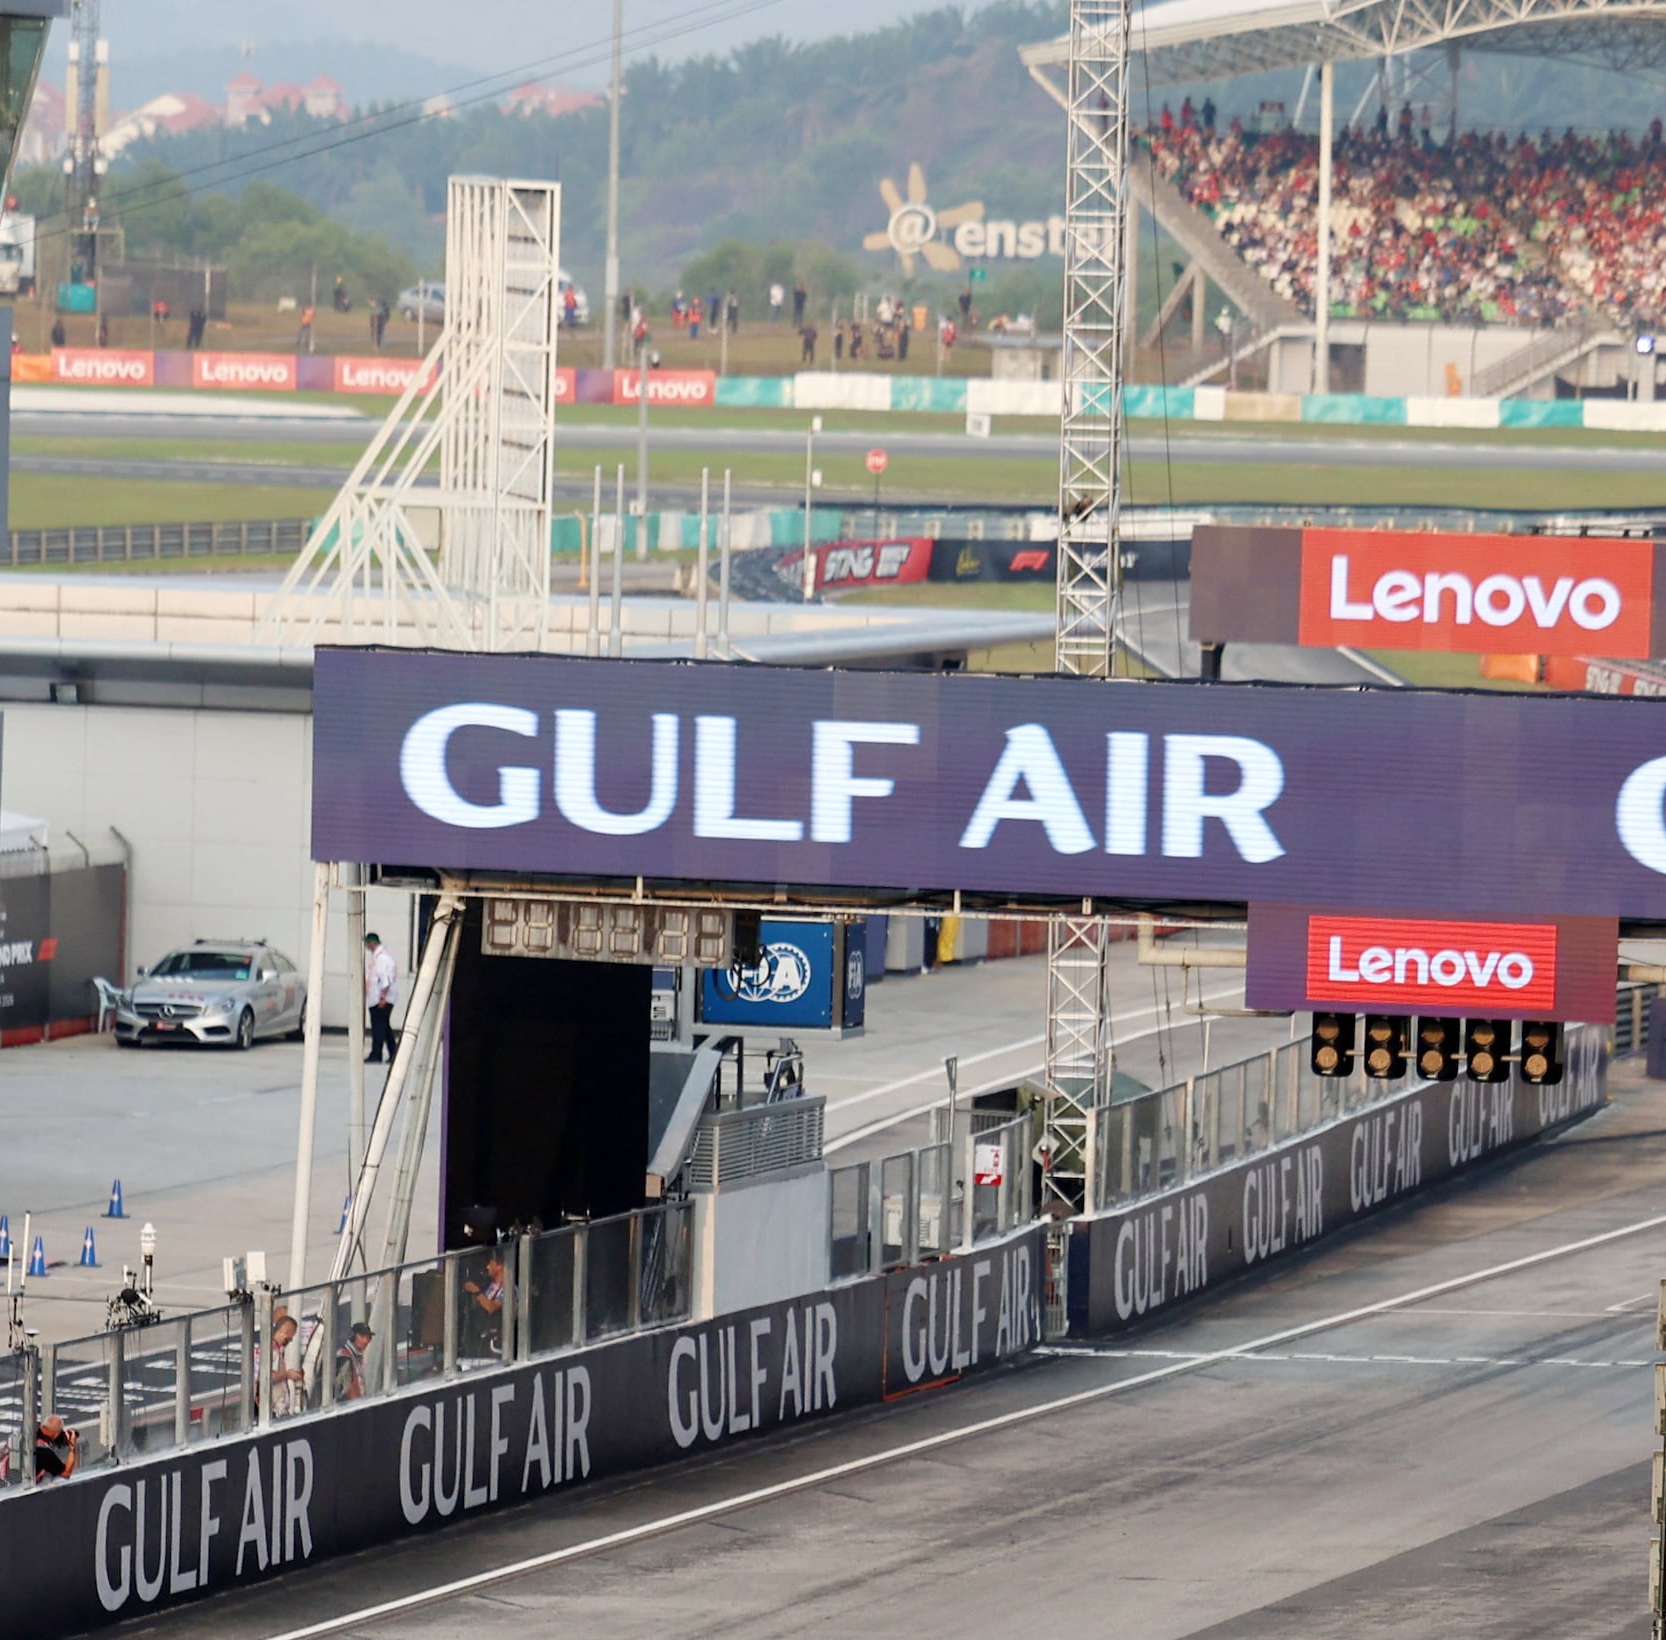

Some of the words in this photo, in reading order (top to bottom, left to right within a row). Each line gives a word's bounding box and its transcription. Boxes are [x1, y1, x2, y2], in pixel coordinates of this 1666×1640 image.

[58, 355, 145, 380] Lenovo
[202, 357, 289, 384] Lenovo
[1331, 555, 1621, 631] Lenovo
[400, 702, 920, 844] GULF
[959, 723, 1287, 864] AIR
[11, 940, 33, 966] PRIX
[1328, 935, 1534, 989] Lenovo
[1243, 1156, 1291, 1265] GULF
[1294, 1144, 1323, 1245] AIR
[1349, 1110, 1396, 1213] GULF
[1394, 1101, 1422, 1193] AIR
[902, 1260, 991, 1383] GULF
[995, 1245, 1040, 1357] AIR
[1113, 1205, 1173, 1320] GULF
[1175, 1193, 1209, 1298] AIR
[667, 1318, 771, 1448] GULF
[779, 1302, 837, 1419] AIR
[399, 1383, 515, 1525] GULF
[521, 1365, 592, 1493] AIR
[94, 1459, 225, 1611] GULF
[235, 1438, 313, 1576] AIR
